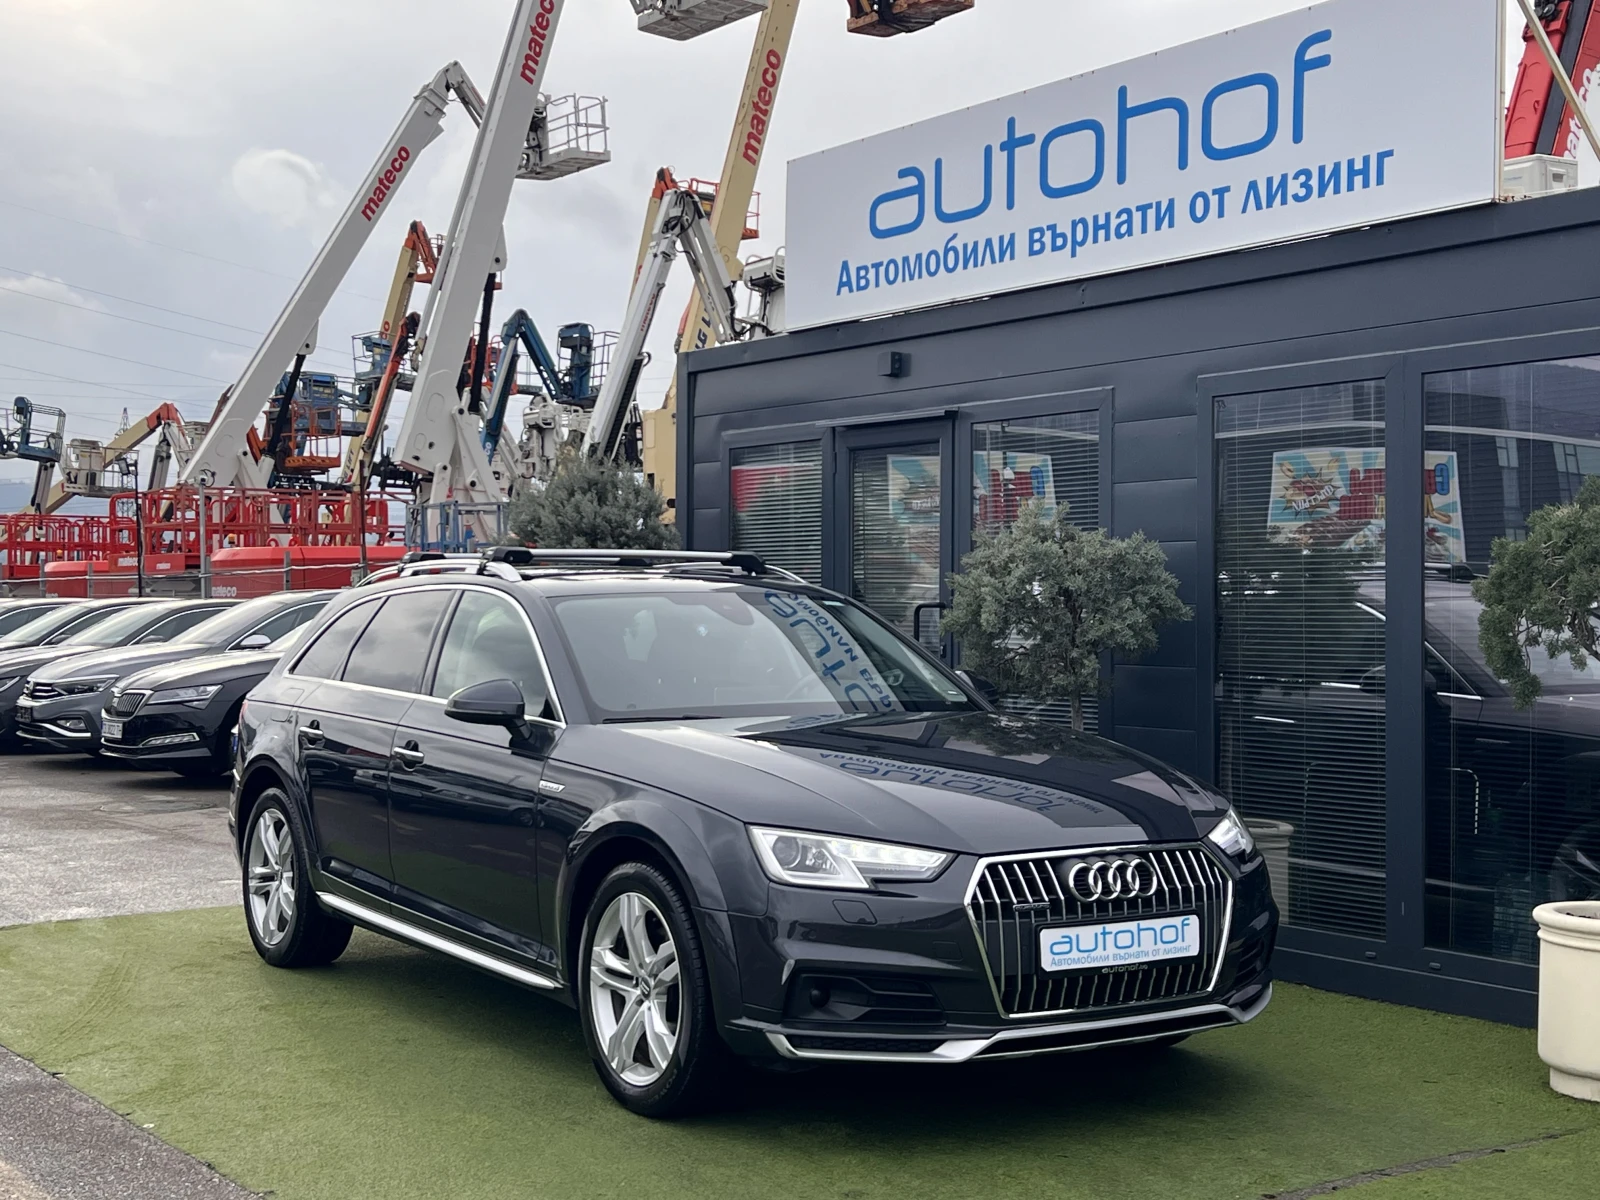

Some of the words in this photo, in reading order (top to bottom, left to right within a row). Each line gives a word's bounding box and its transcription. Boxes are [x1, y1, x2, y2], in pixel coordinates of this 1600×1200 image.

[743, 49, 781, 164] mateco
[868, 29, 1332, 240] autohof
[362, 146, 410, 220] mateco
[836, 232, 1016, 295] Автомобили
[1027, 197, 1176, 258] върнати
[1188, 185, 1231, 224] от
[1241, 149, 1394, 214] лизинг
[1049, 916, 1191, 957] autohof
[1050, 953, 1110, 967] Автомобили
[1112, 950, 1149, 962] върнати
[1152, 948, 1161, 957] от
[1162, 944, 1192, 956] лизинг
